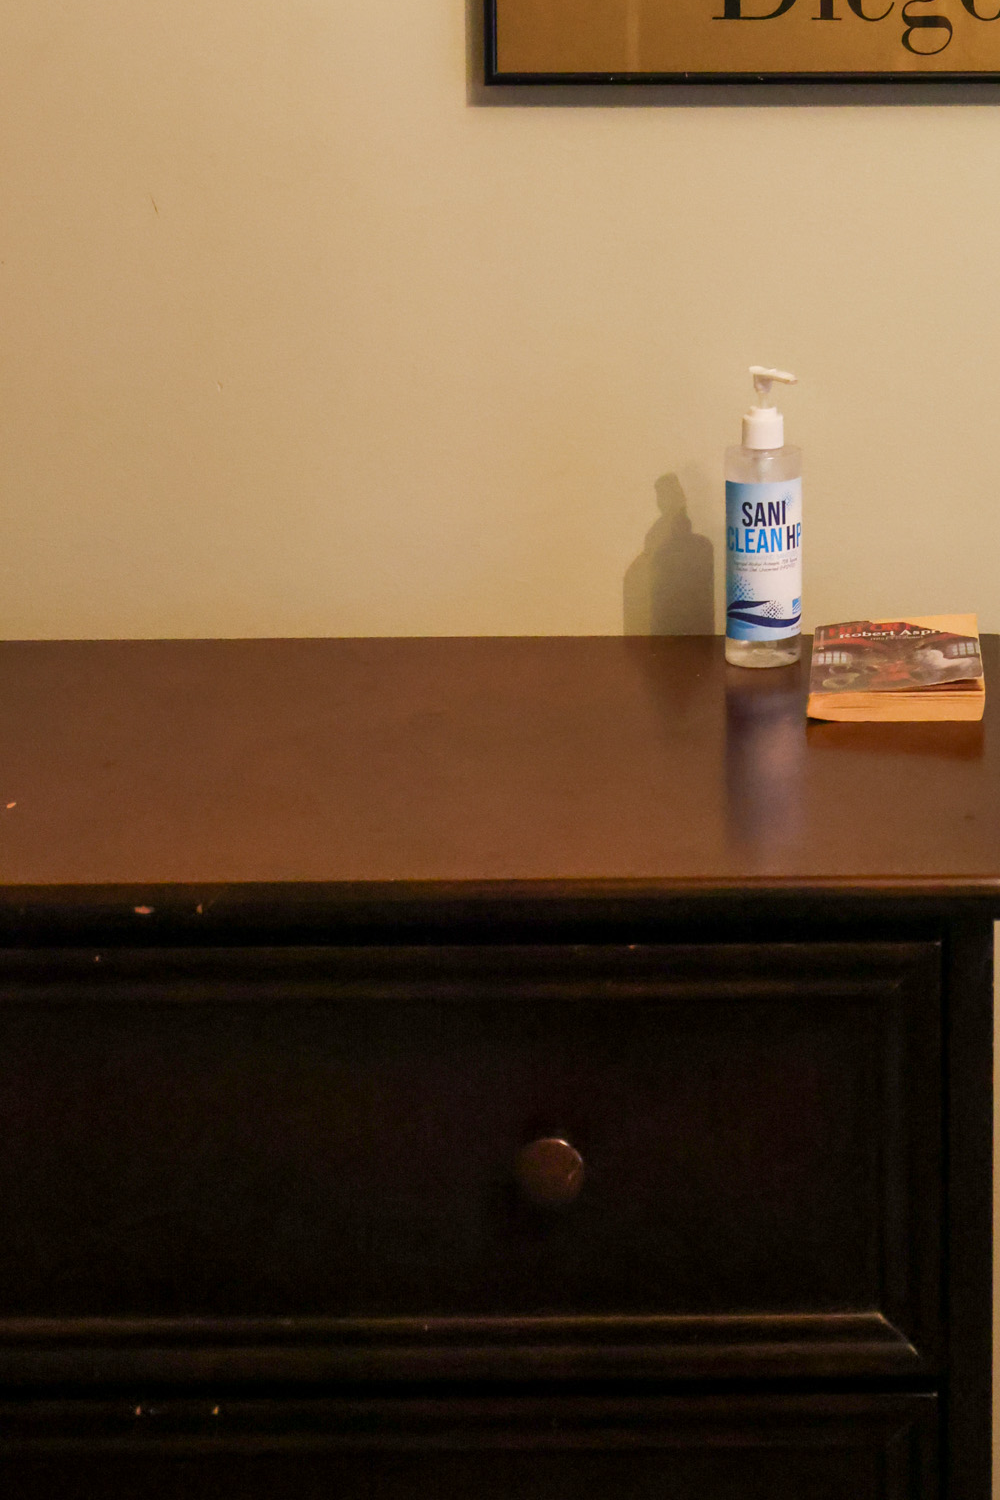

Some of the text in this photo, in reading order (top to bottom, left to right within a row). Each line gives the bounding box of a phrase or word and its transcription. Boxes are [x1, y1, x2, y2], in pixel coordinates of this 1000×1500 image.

[741, 500, 787, 527] SANI
[727, 522, 802, 553] CLEAN HP
[839, 629, 895, 640] Robert
